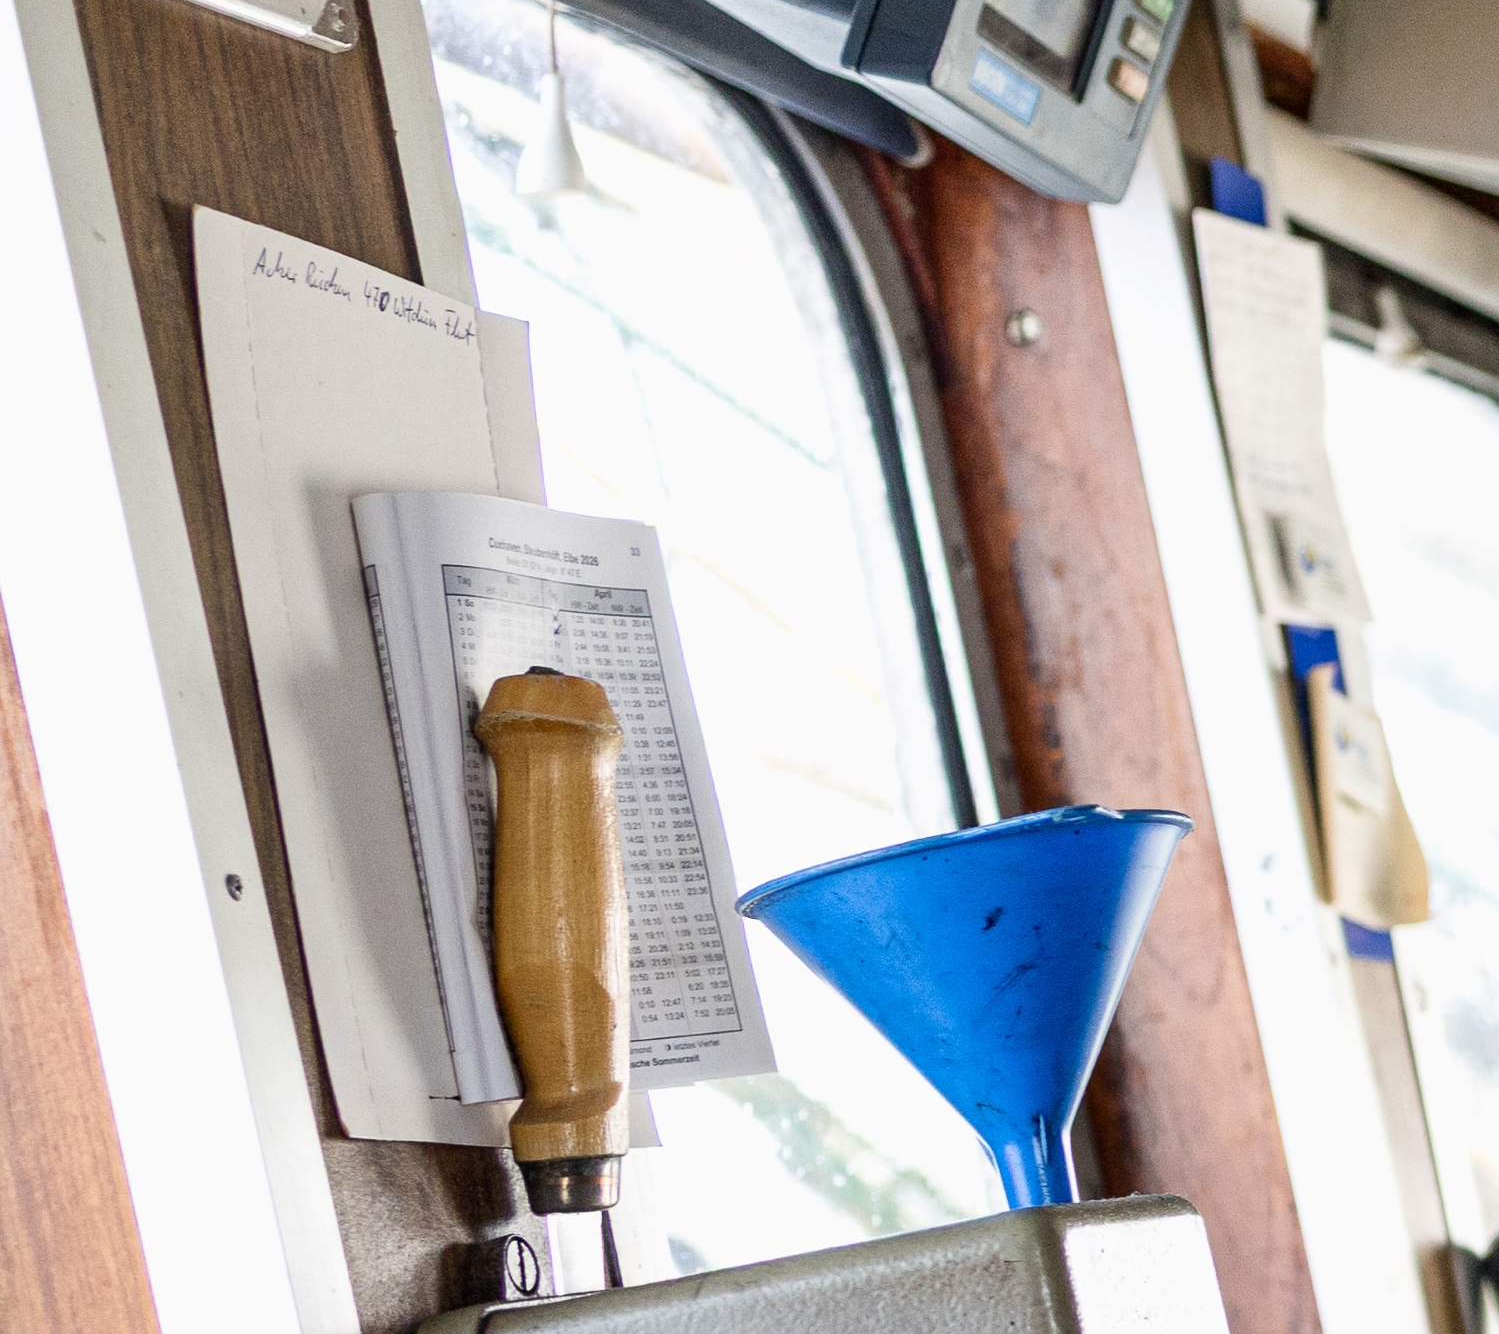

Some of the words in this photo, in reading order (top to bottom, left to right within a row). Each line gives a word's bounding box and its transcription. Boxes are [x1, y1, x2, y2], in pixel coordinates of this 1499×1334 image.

[563, 551, 580, 565] Elbe
[457, 575, 472, 587] Tag
[594, 589, 613, 599] April
[653, 1054, 700, 1066] Sommerzeit
